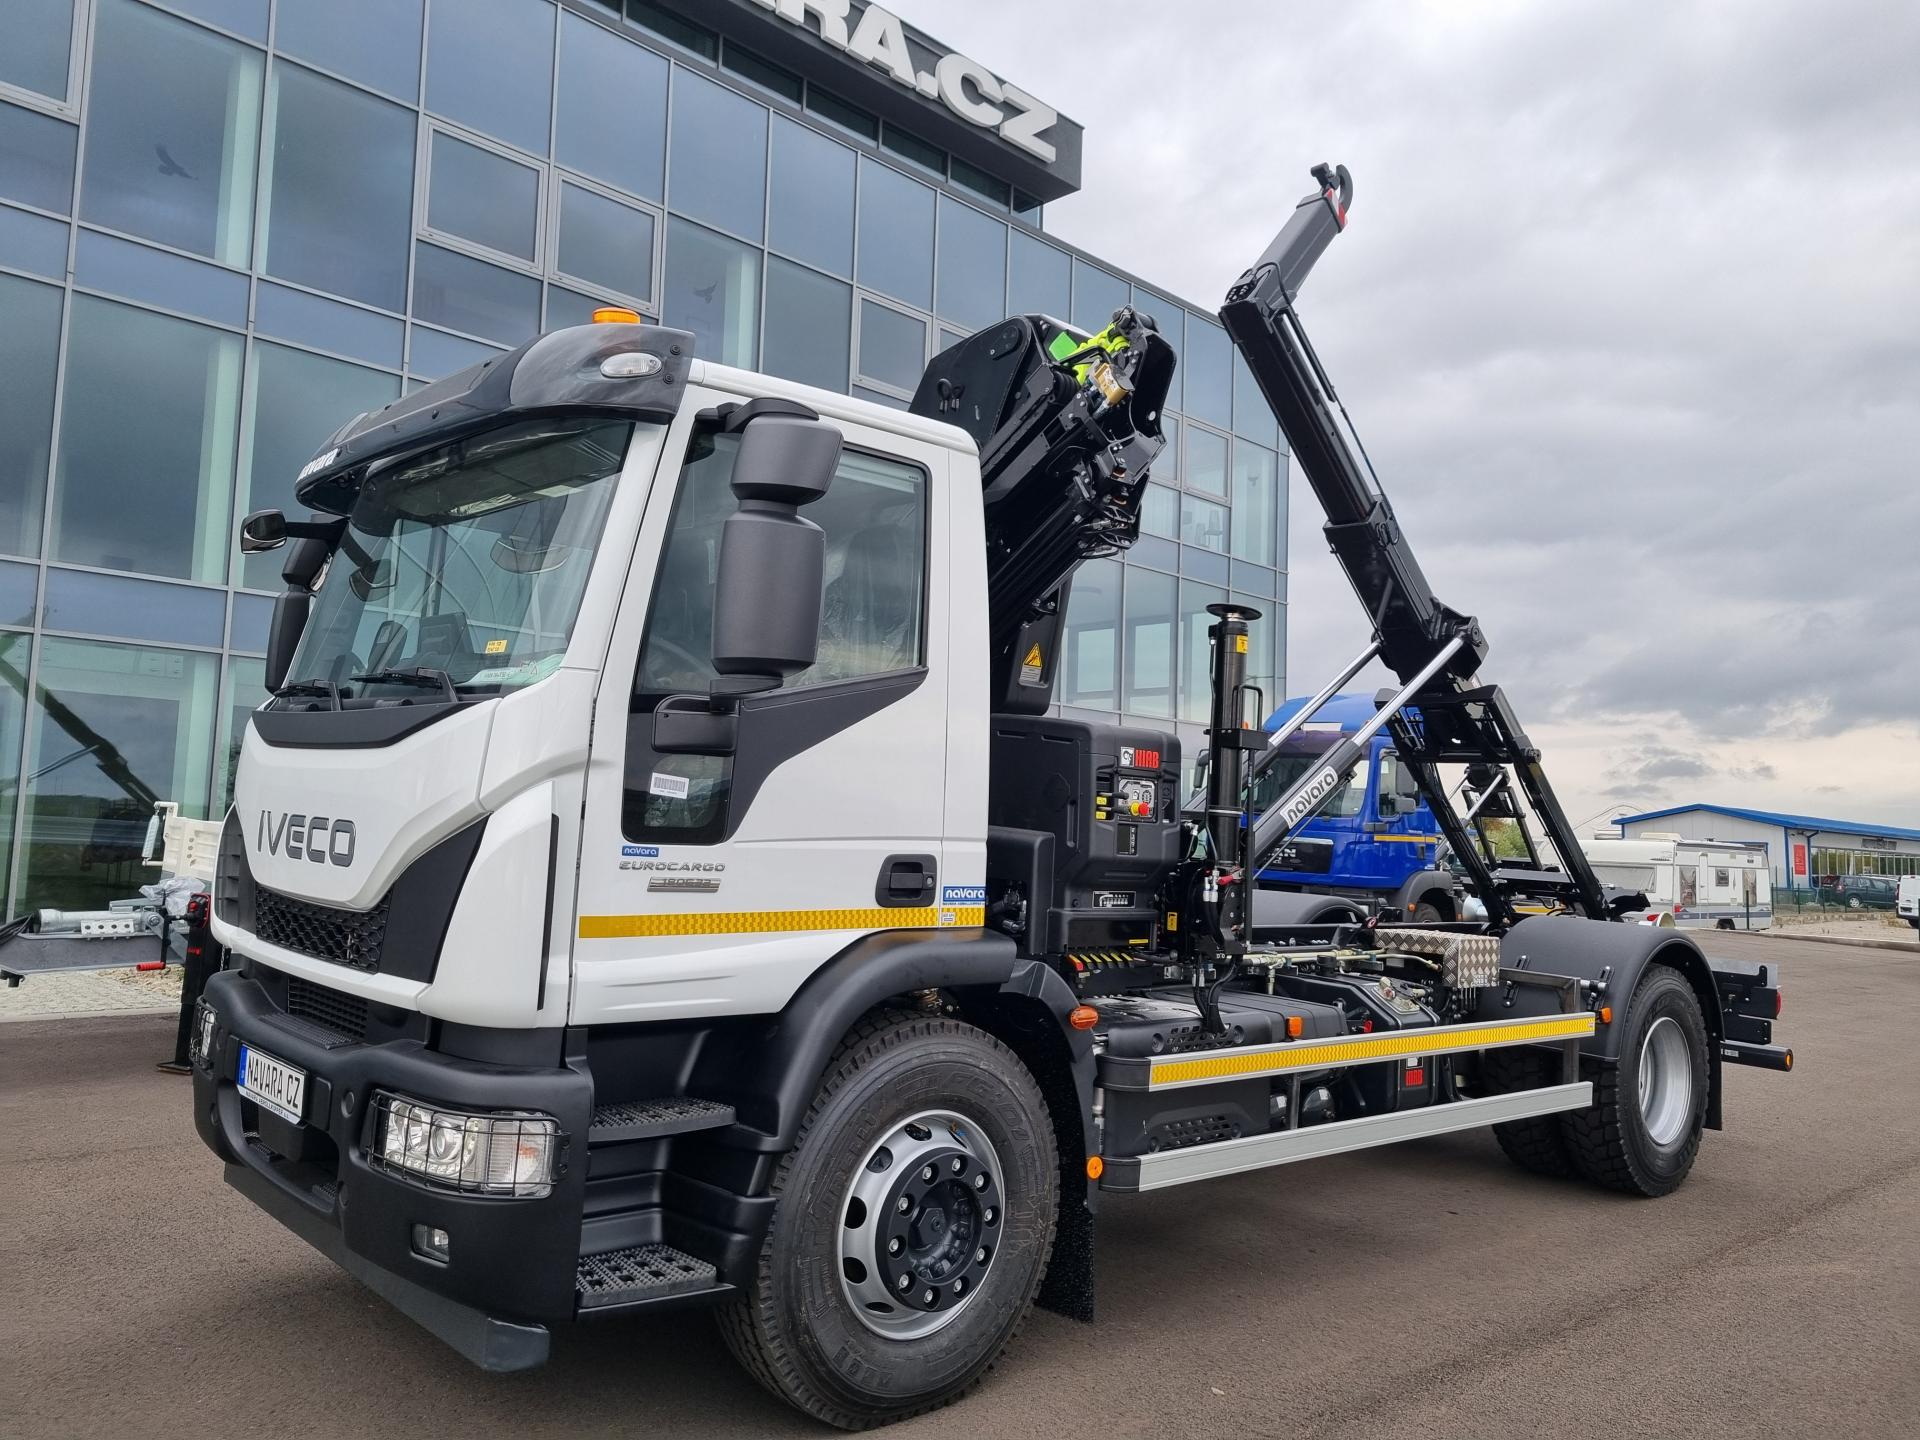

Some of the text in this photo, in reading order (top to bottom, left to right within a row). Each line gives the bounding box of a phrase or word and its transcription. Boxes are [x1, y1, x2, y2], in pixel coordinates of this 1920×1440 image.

[754, 0, 1057, 163] RA.CZ
[1135, 749, 1159, 768] HIAB
[257, 809, 357, 868] IVECO
[619, 860, 726, 872] EUROCARGO
[247, 1055, 301, 1109] NAVARA CZ
